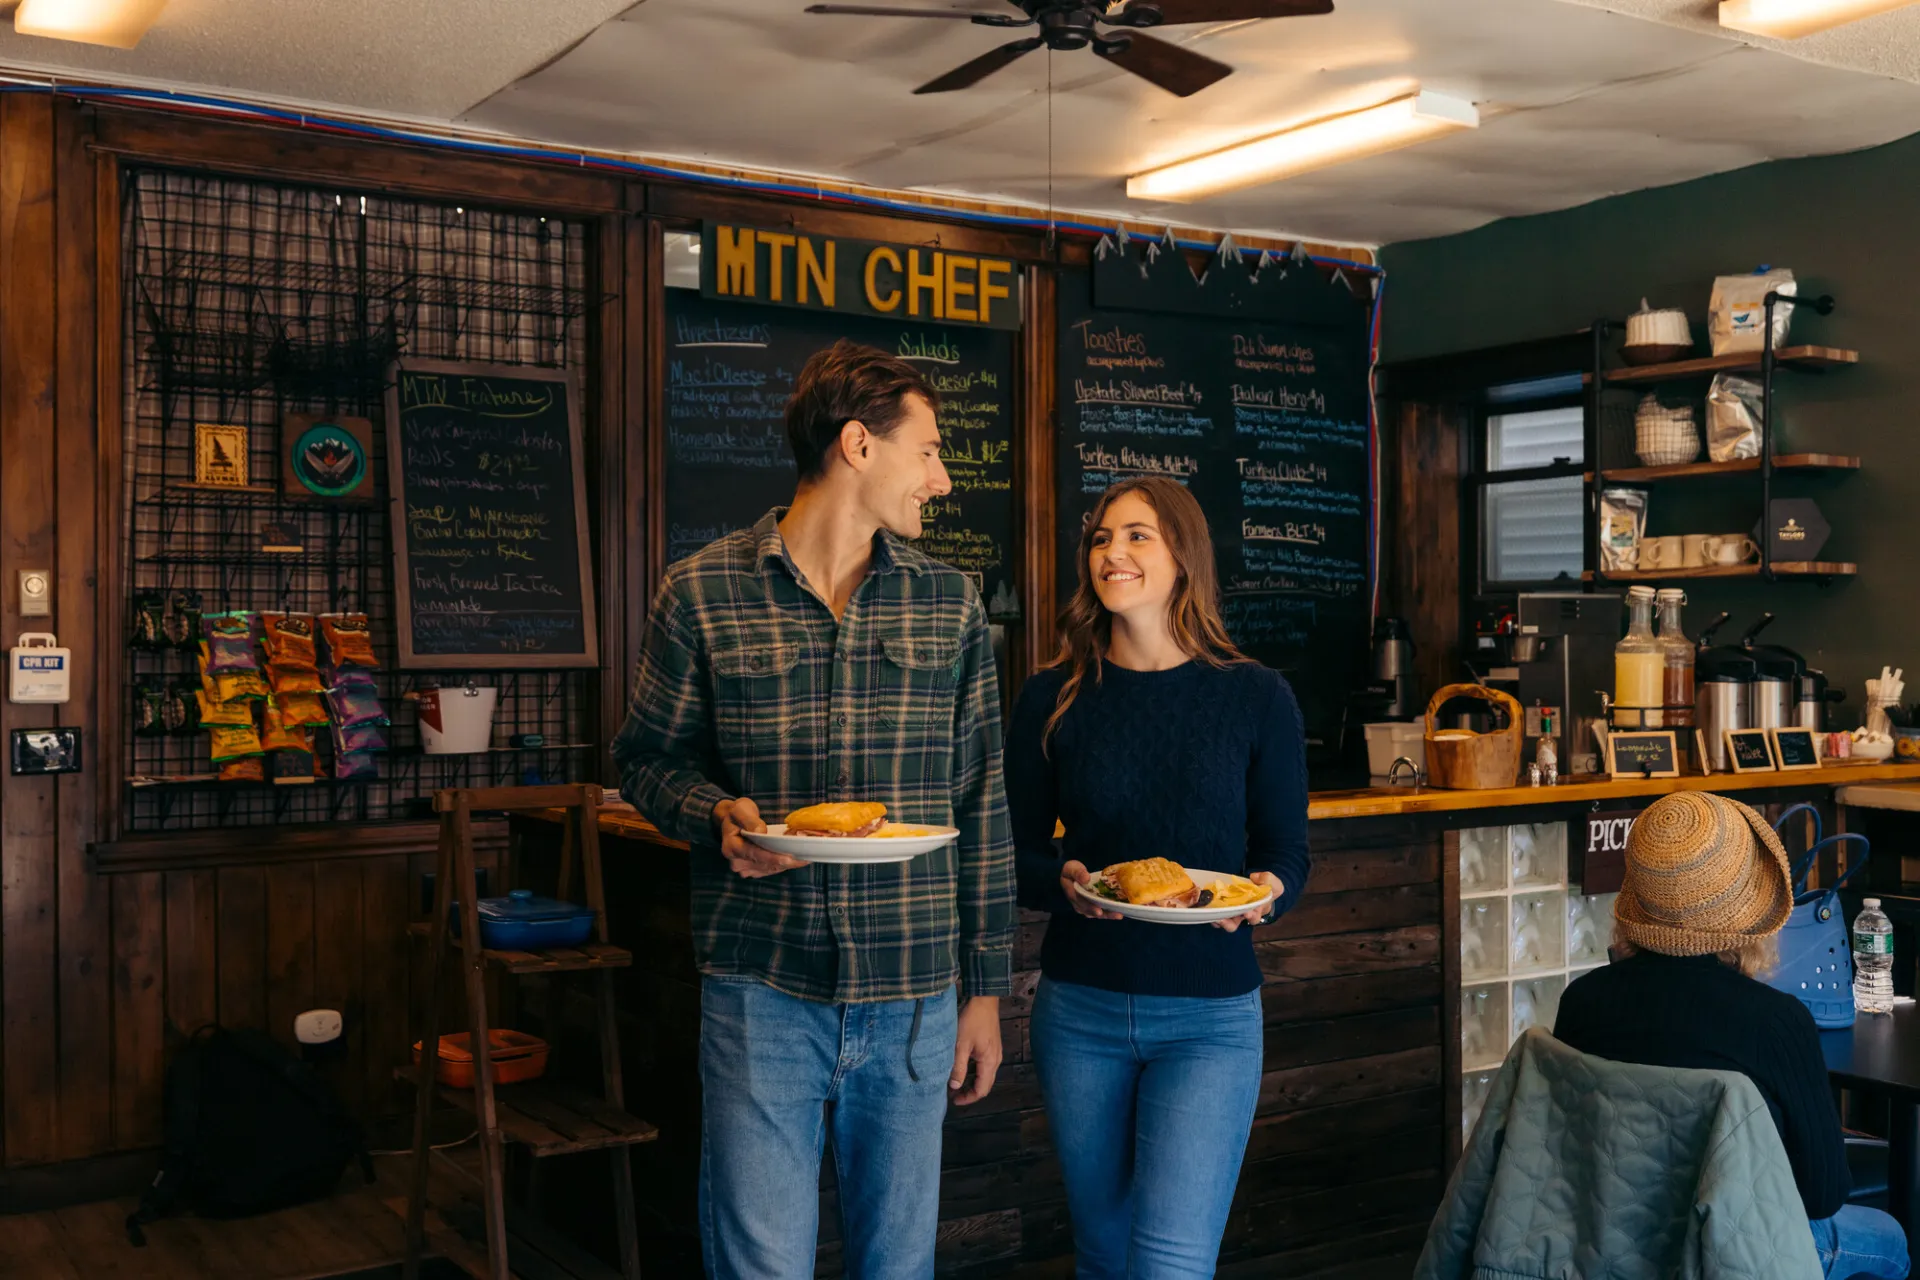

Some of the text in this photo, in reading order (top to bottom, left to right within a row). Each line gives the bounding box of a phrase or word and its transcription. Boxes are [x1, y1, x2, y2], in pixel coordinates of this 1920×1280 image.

[716, 225, 1011, 322] MTN CHEF
[898, 332, 960, 360] Salads
[1071, 320, 1147, 355] Toasties
[403, 376, 447, 405] MTN
[930, 366, 974, 389] Caesar
[408, 447, 456, 468] Rolls
[940, 437, 973, 460] alad
[1074, 441, 1118, 470] Turkey
[1235, 457, 1277, 482] Turkey
[1285, 522, 1309, 538] BLT
[414, 567, 449, 595] Fresh
[526, 574, 563, 595] Tea
[23, 657, 60, 669] CPR KIT
